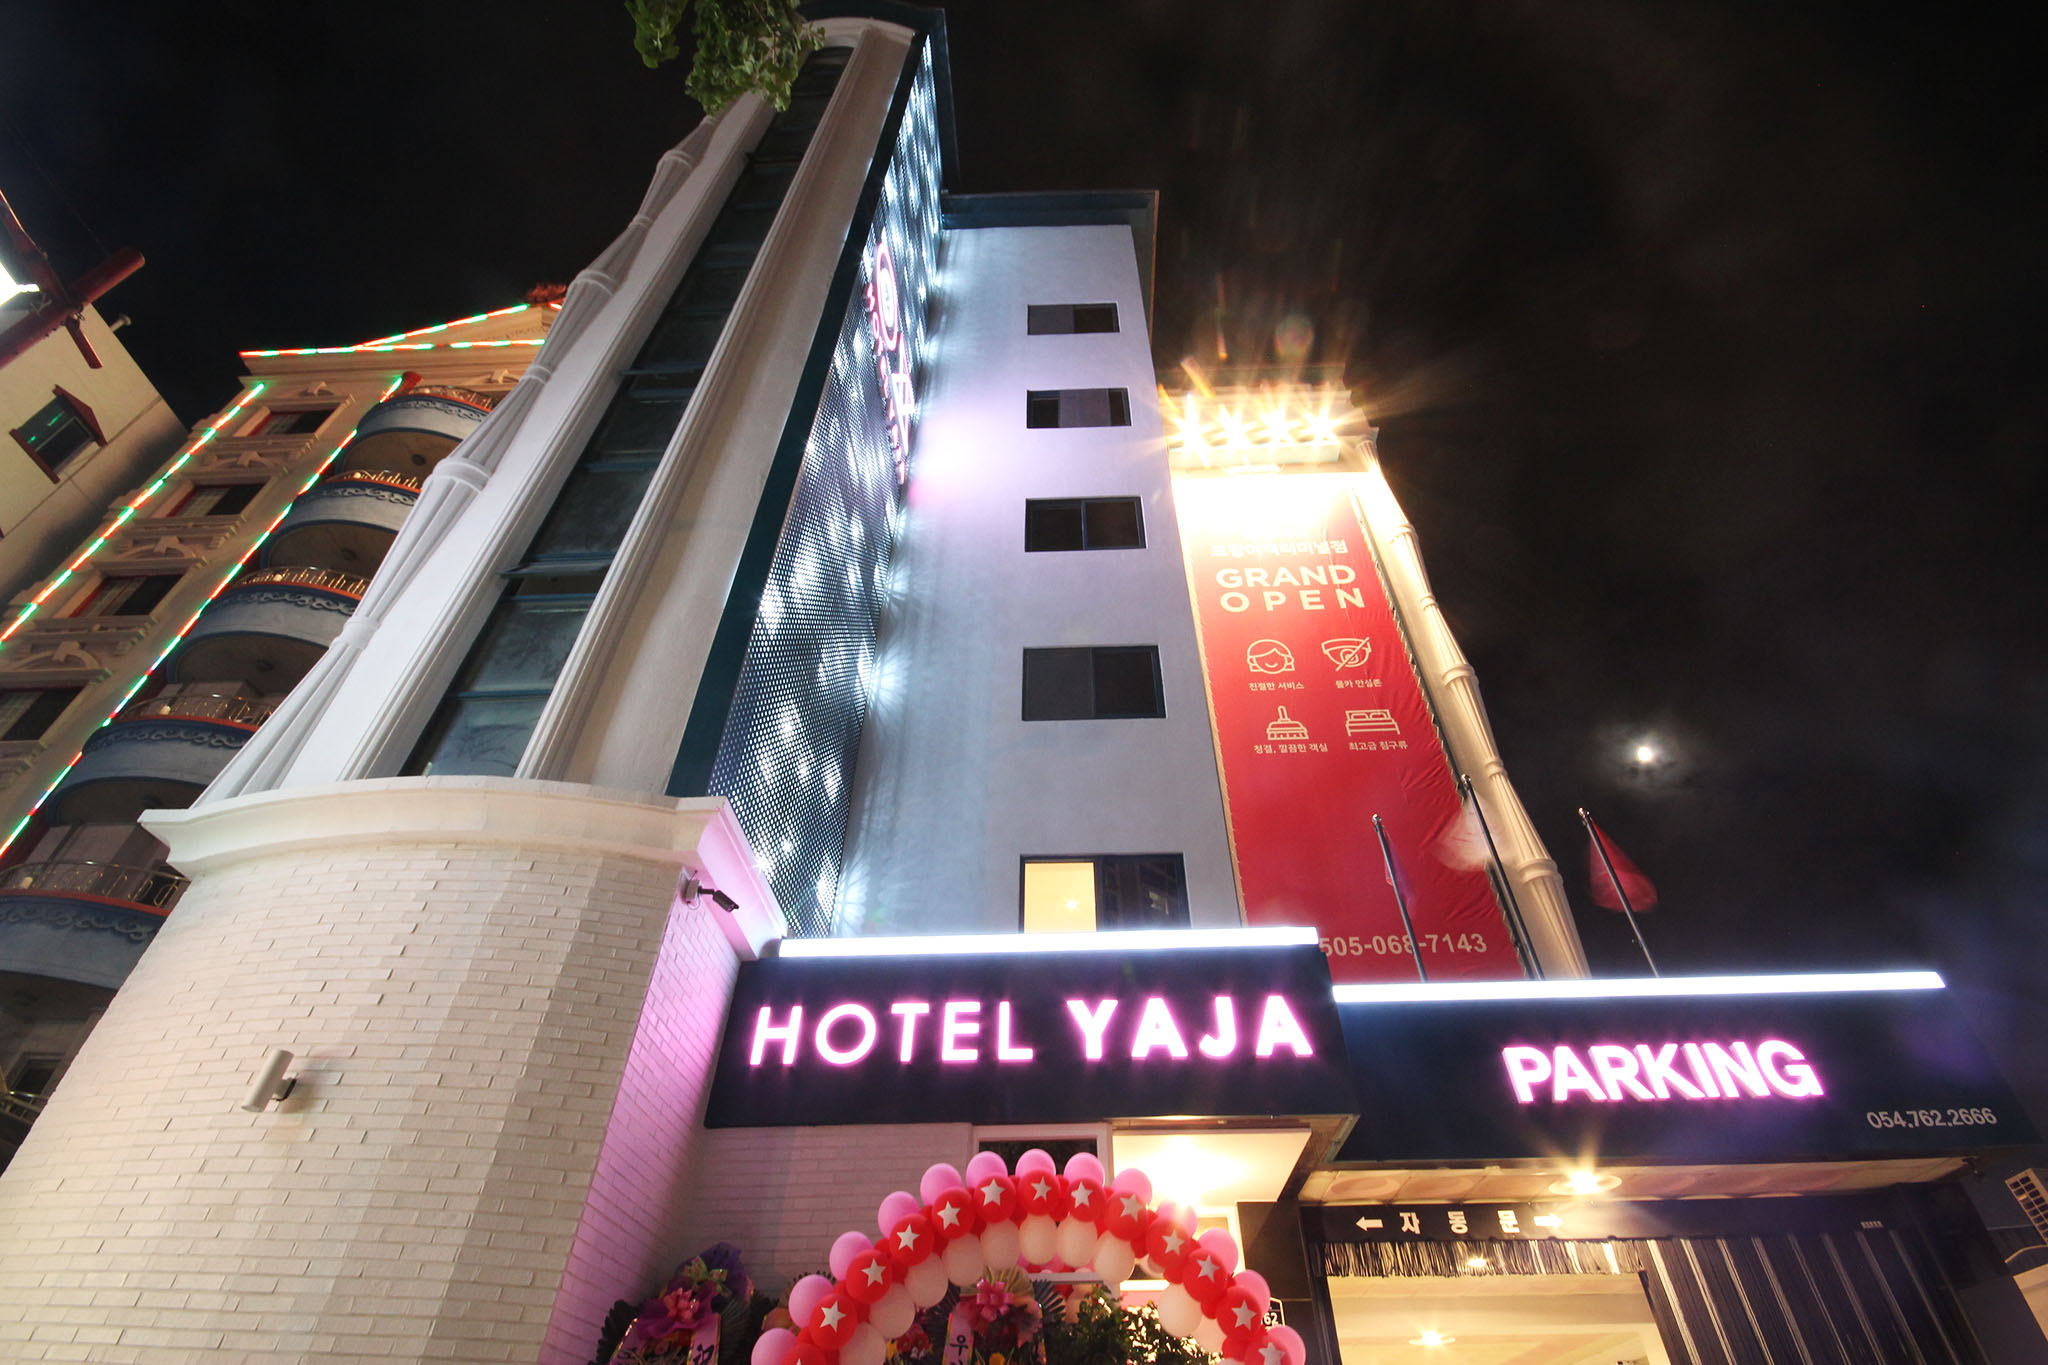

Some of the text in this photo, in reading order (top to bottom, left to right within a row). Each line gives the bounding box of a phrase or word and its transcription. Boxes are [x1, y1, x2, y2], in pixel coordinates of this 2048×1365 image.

[1215, 564, 1356, 588] GRAND
[1220, 588, 1366, 613] OPEN
[1248, 681, 1305, 691] 친절한 서비스
[750, 995, 1314, 1066] HOTEL YAJA
[1502, 1039, 1825, 1104] PARKING
[1866, 1107, 1998, 1129] 054.762.2666
